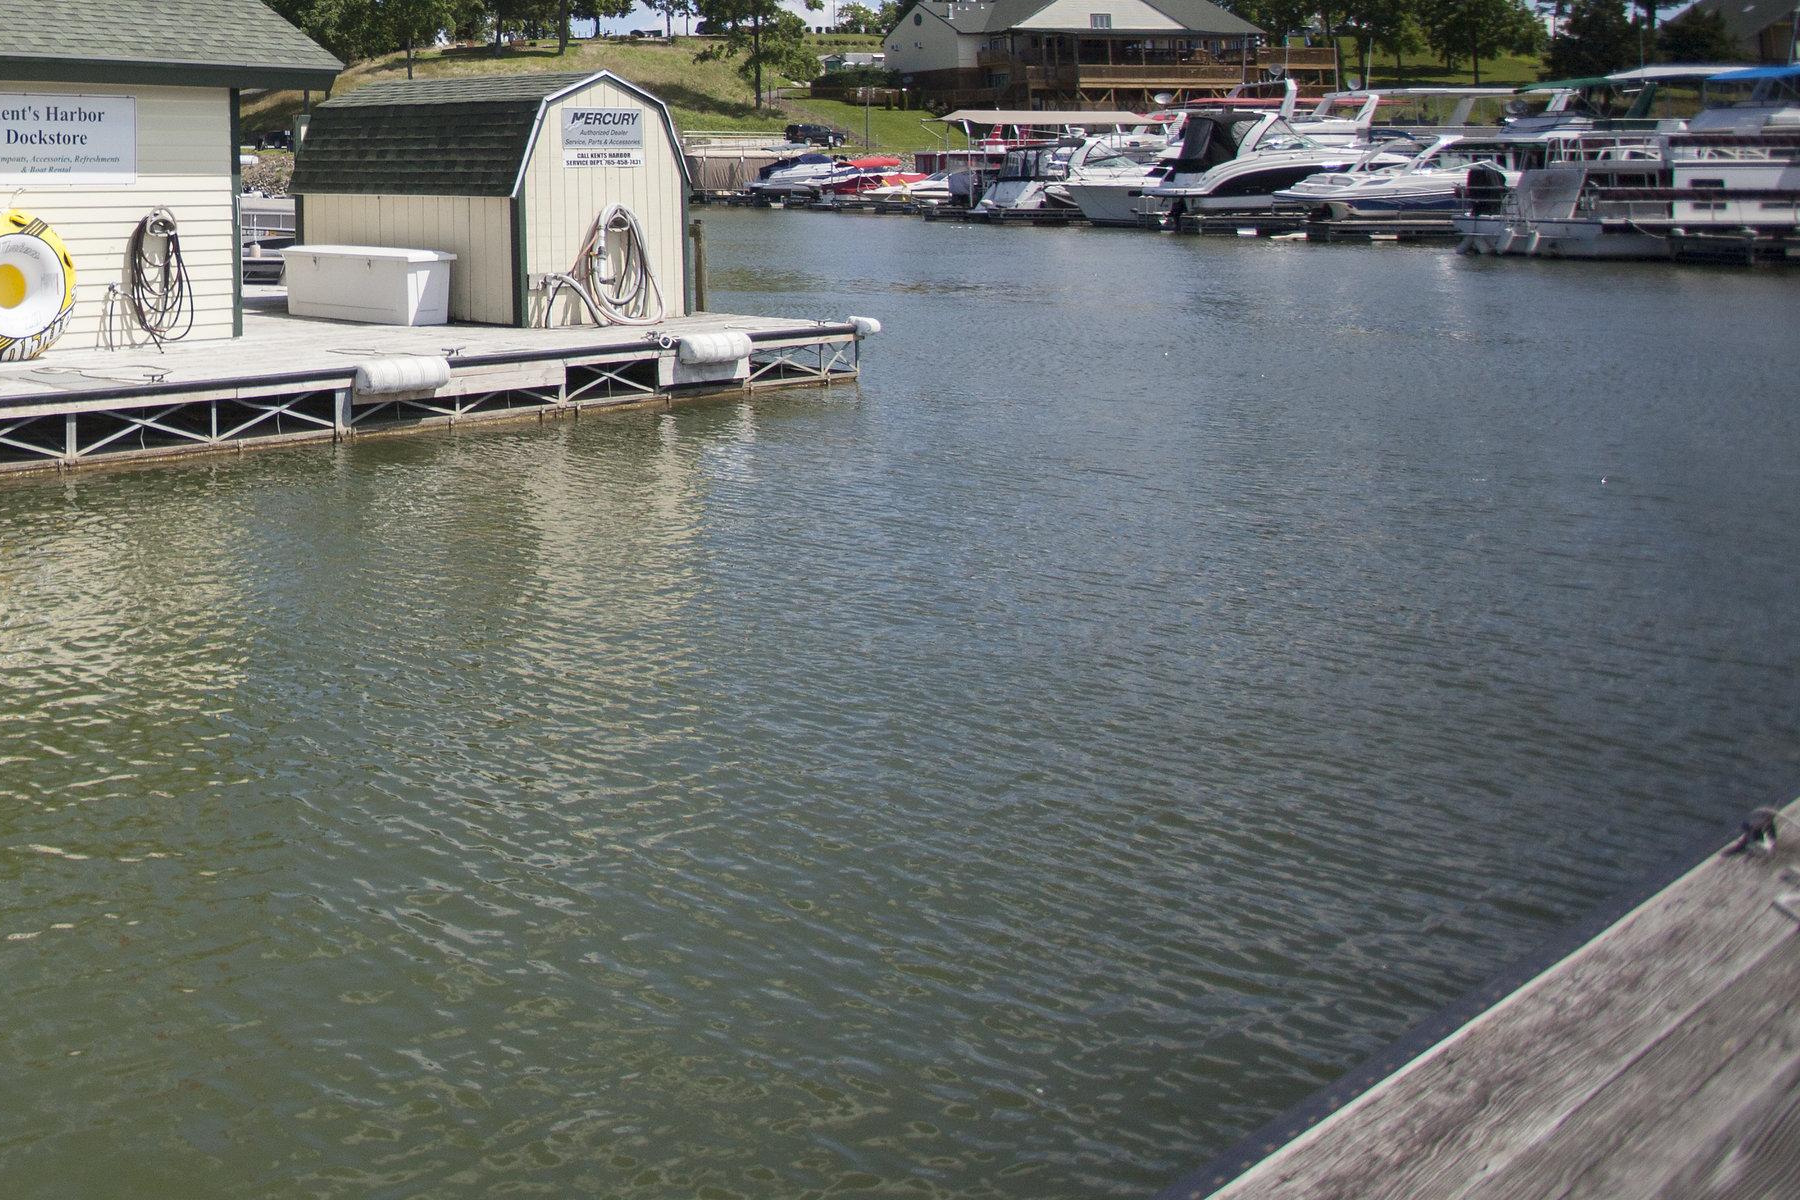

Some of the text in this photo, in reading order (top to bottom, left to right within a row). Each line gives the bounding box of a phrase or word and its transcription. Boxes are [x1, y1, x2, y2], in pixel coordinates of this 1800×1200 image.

[45, 106, 105, 122] Harbor
[571, 112, 639, 125] MERCURY
[6, 129, 88, 145] Dockstore
[32, 155, 73, 163] Accessories,
[74, 155, 120, 164] Refreshments
